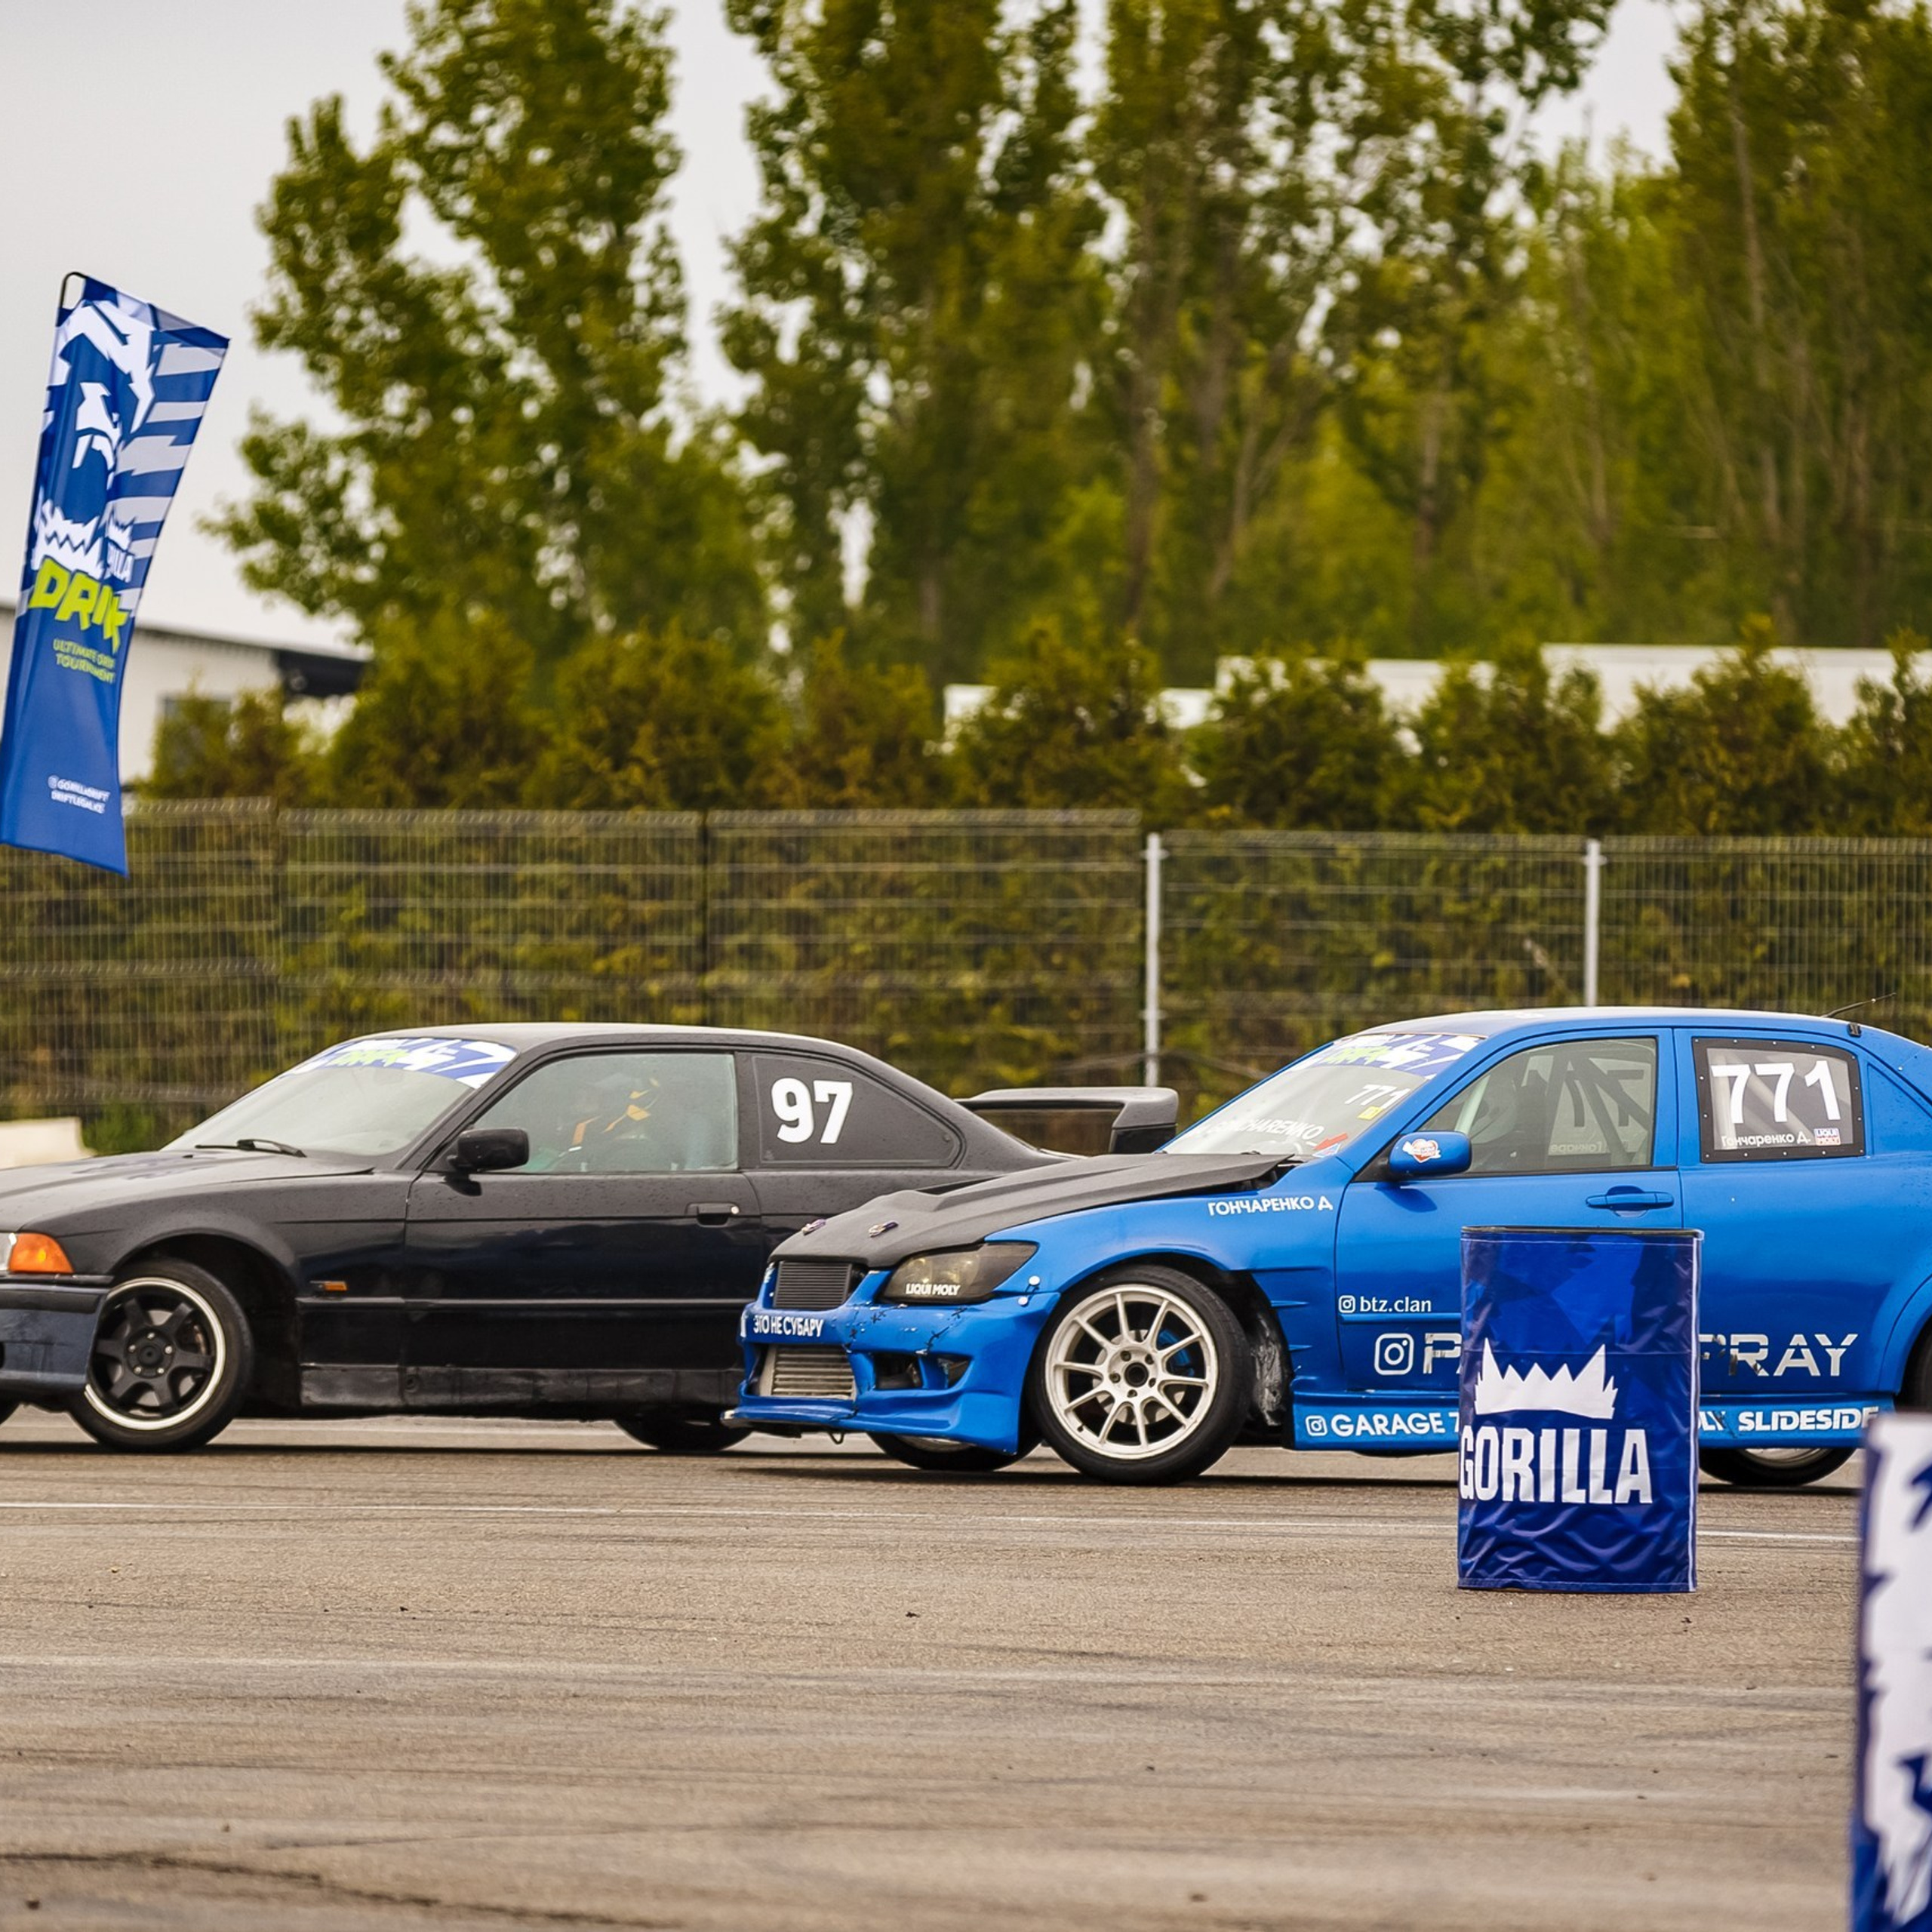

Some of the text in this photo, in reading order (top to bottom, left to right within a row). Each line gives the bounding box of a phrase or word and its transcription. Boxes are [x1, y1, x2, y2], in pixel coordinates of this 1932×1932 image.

[1344, 1084, 1411, 1109] 771
[1711, 1060, 1841, 1124] 771
[771, 1078, 853, 1143] 97
[1721, 1134, 1795, 1147] Гончаренко
[1208, 1195, 1334, 1216] ГОНЧАРЕНКО Д
[906, 1283, 961, 1296] LIQUI MOLY
[1359, 1297, 1432, 1312] btz.clan
[771, 1315, 783, 1335] НЕ
[783, 1316, 824, 1337] СУБАРУ
[1423, 1333, 1462, 1374] P
[1331, 1413, 1446, 1437] GARAGE
[1459, 1425, 1653, 1504] GORILLA
